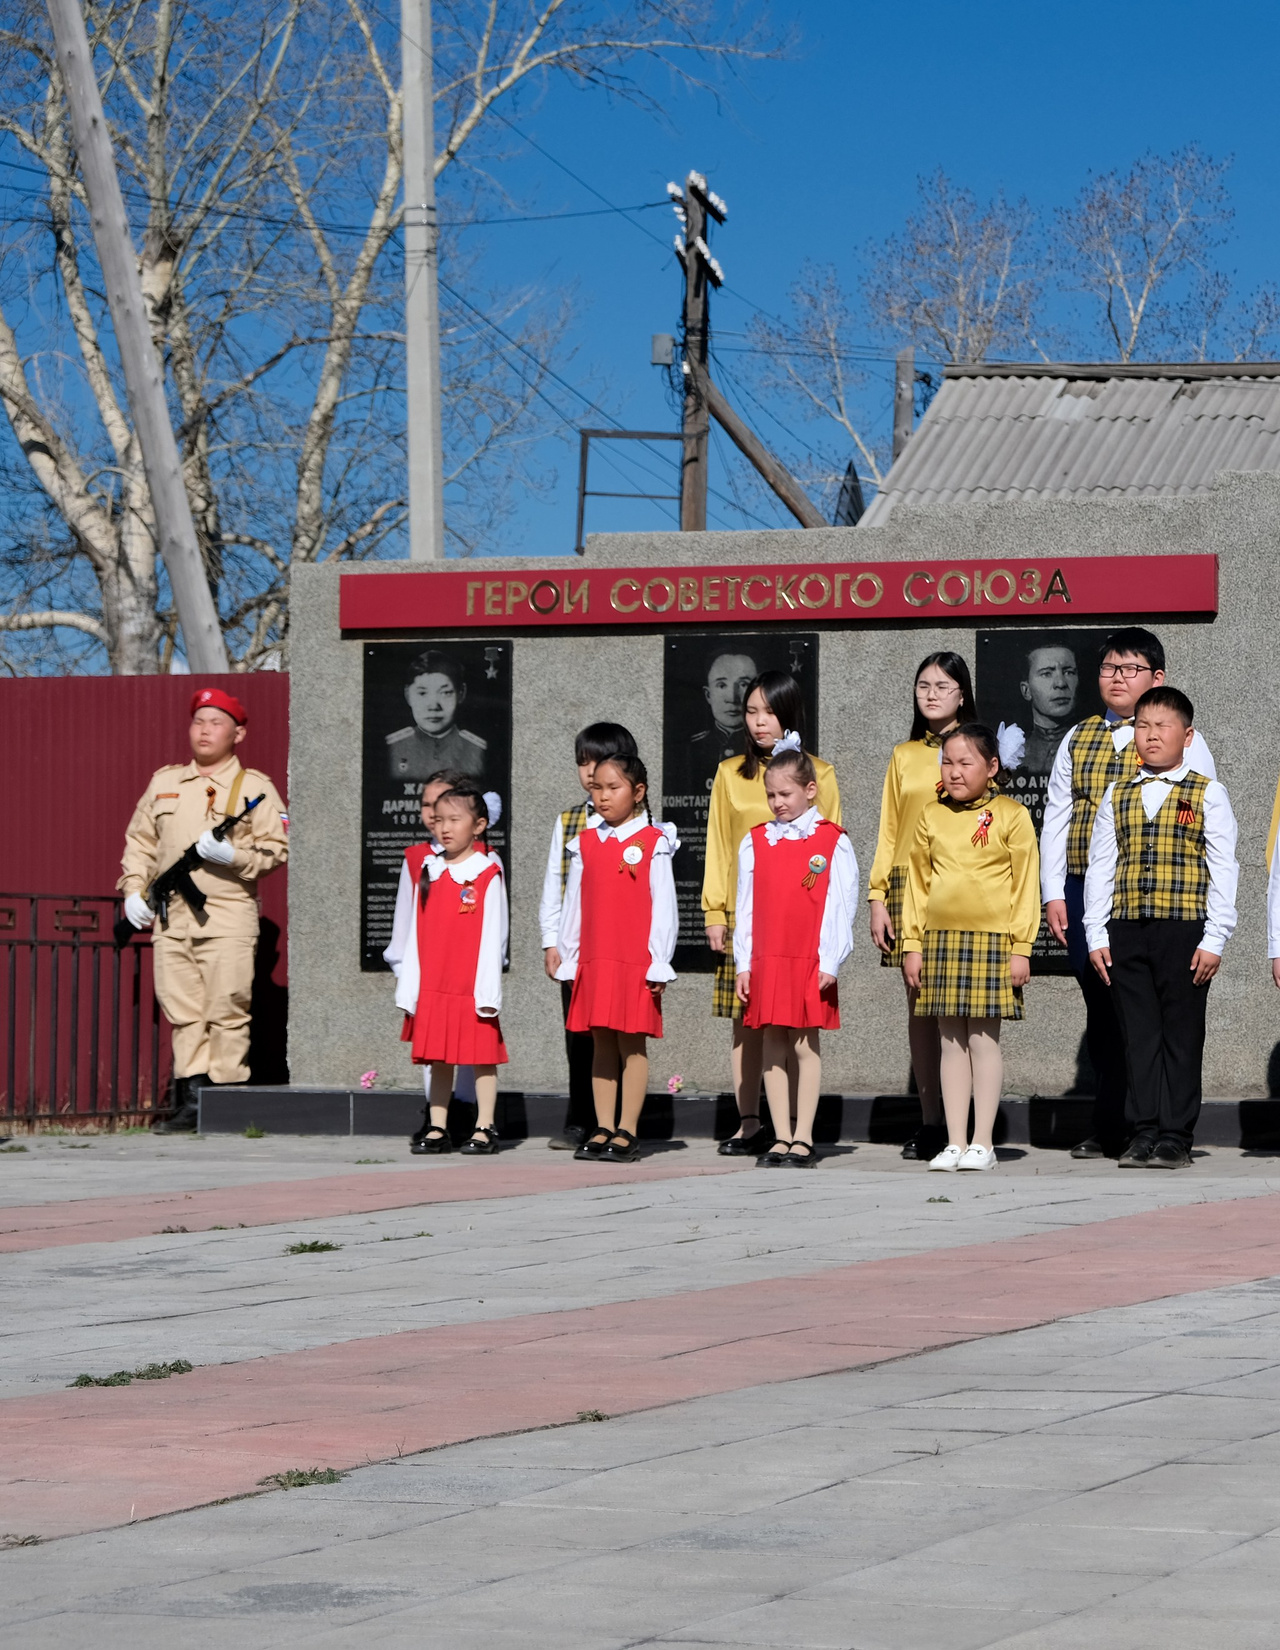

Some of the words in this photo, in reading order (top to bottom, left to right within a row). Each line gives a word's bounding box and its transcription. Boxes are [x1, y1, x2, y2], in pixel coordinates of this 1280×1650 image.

[466, 579, 590, 616] ГЕРОИ
[610, 572, 884, 613] СОВЕТСКОГО
[903, 568, 1072, 607] СОЮЗА
